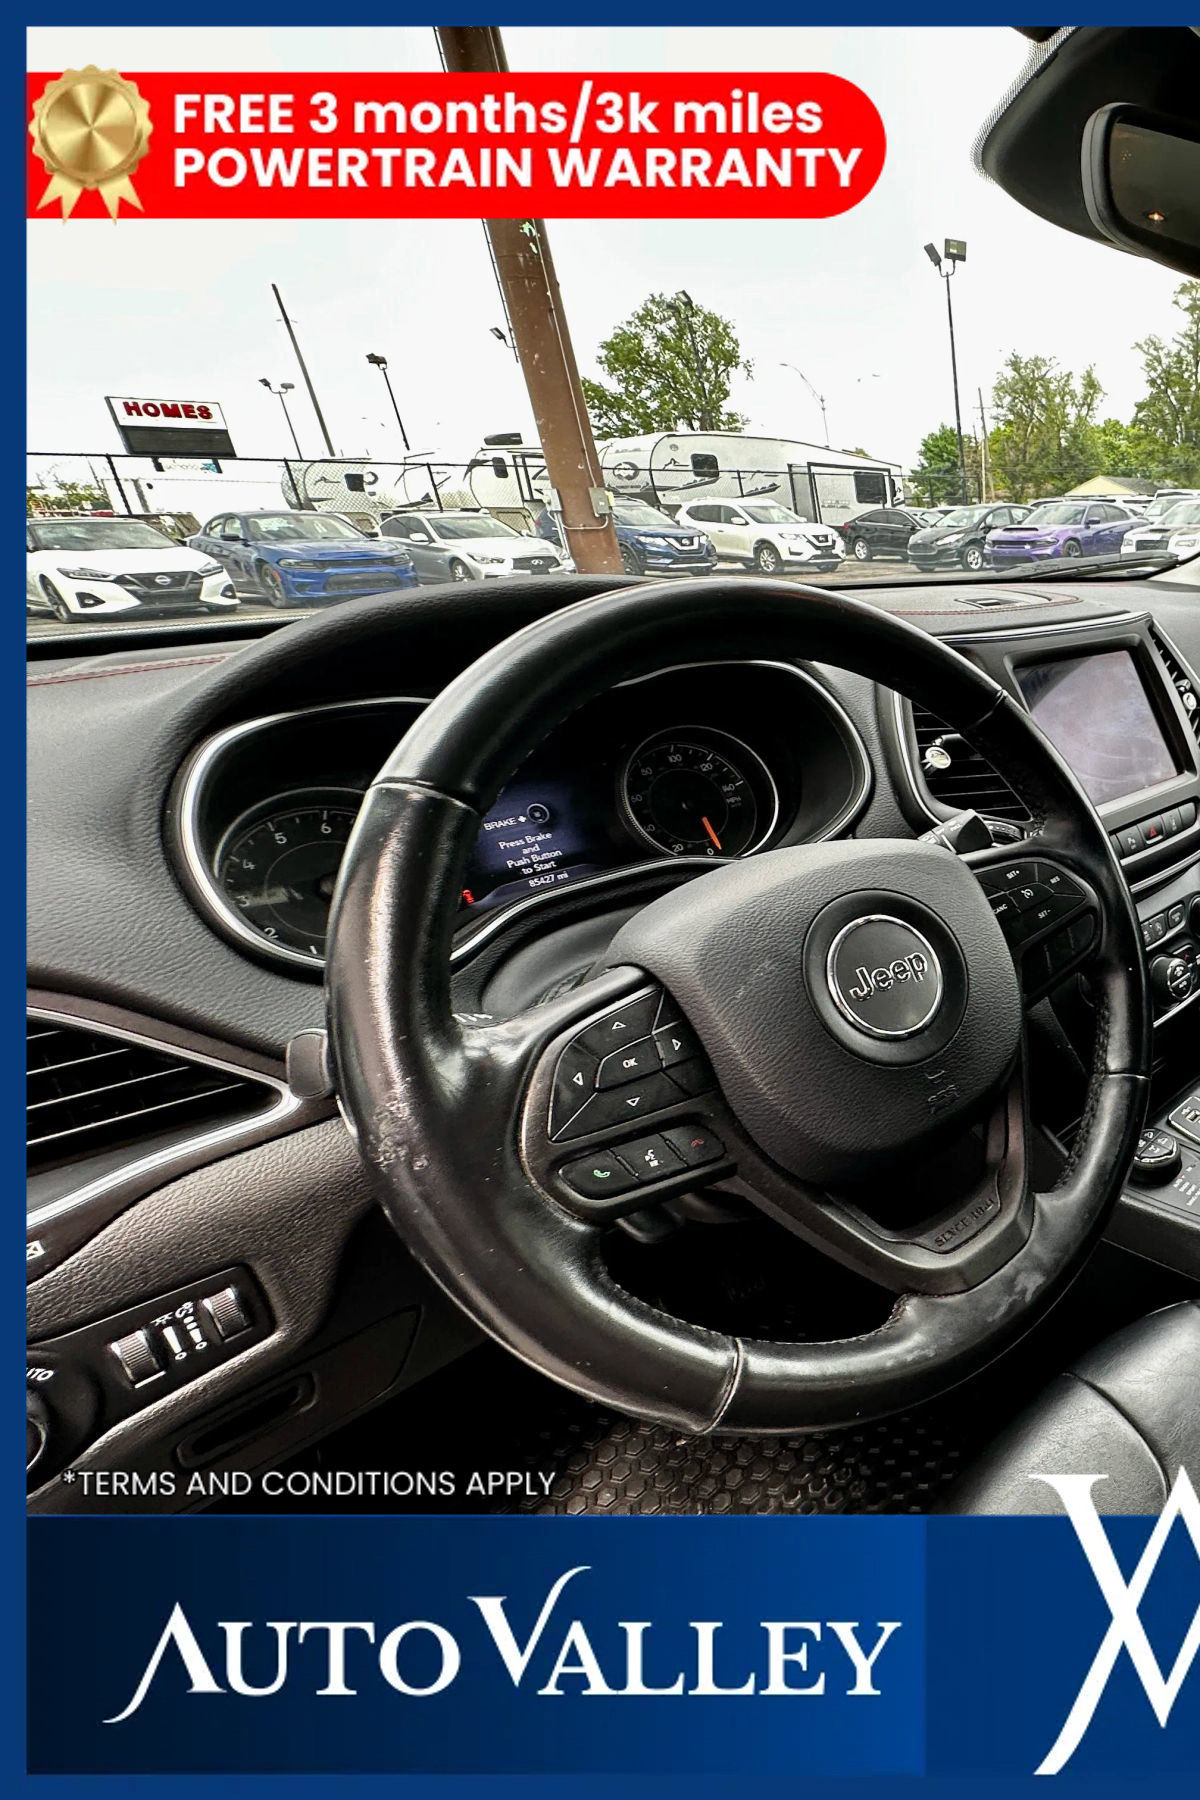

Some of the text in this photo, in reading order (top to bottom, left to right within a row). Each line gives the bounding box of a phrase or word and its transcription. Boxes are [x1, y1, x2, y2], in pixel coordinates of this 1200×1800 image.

[122, 401, 213, 420] HOMES
[321, 822, 332, 834] 6
[483, 817, 518, 831] BRAKE
[274, 832, 288, 845] 5
[498, 832, 552, 850] Press Brake
[522, 843, 541, 855] and
[242, 859, 257, 870] 4
[506, 849, 563, 869] Push Button
[521, 860, 557, 875] to Start
[528, 870, 569, 888] 85427 mi
[263, 927, 279, 939] 2
[849, 951, 929, 1001] Jeep
[622, 1057, 639, 1069] OK
